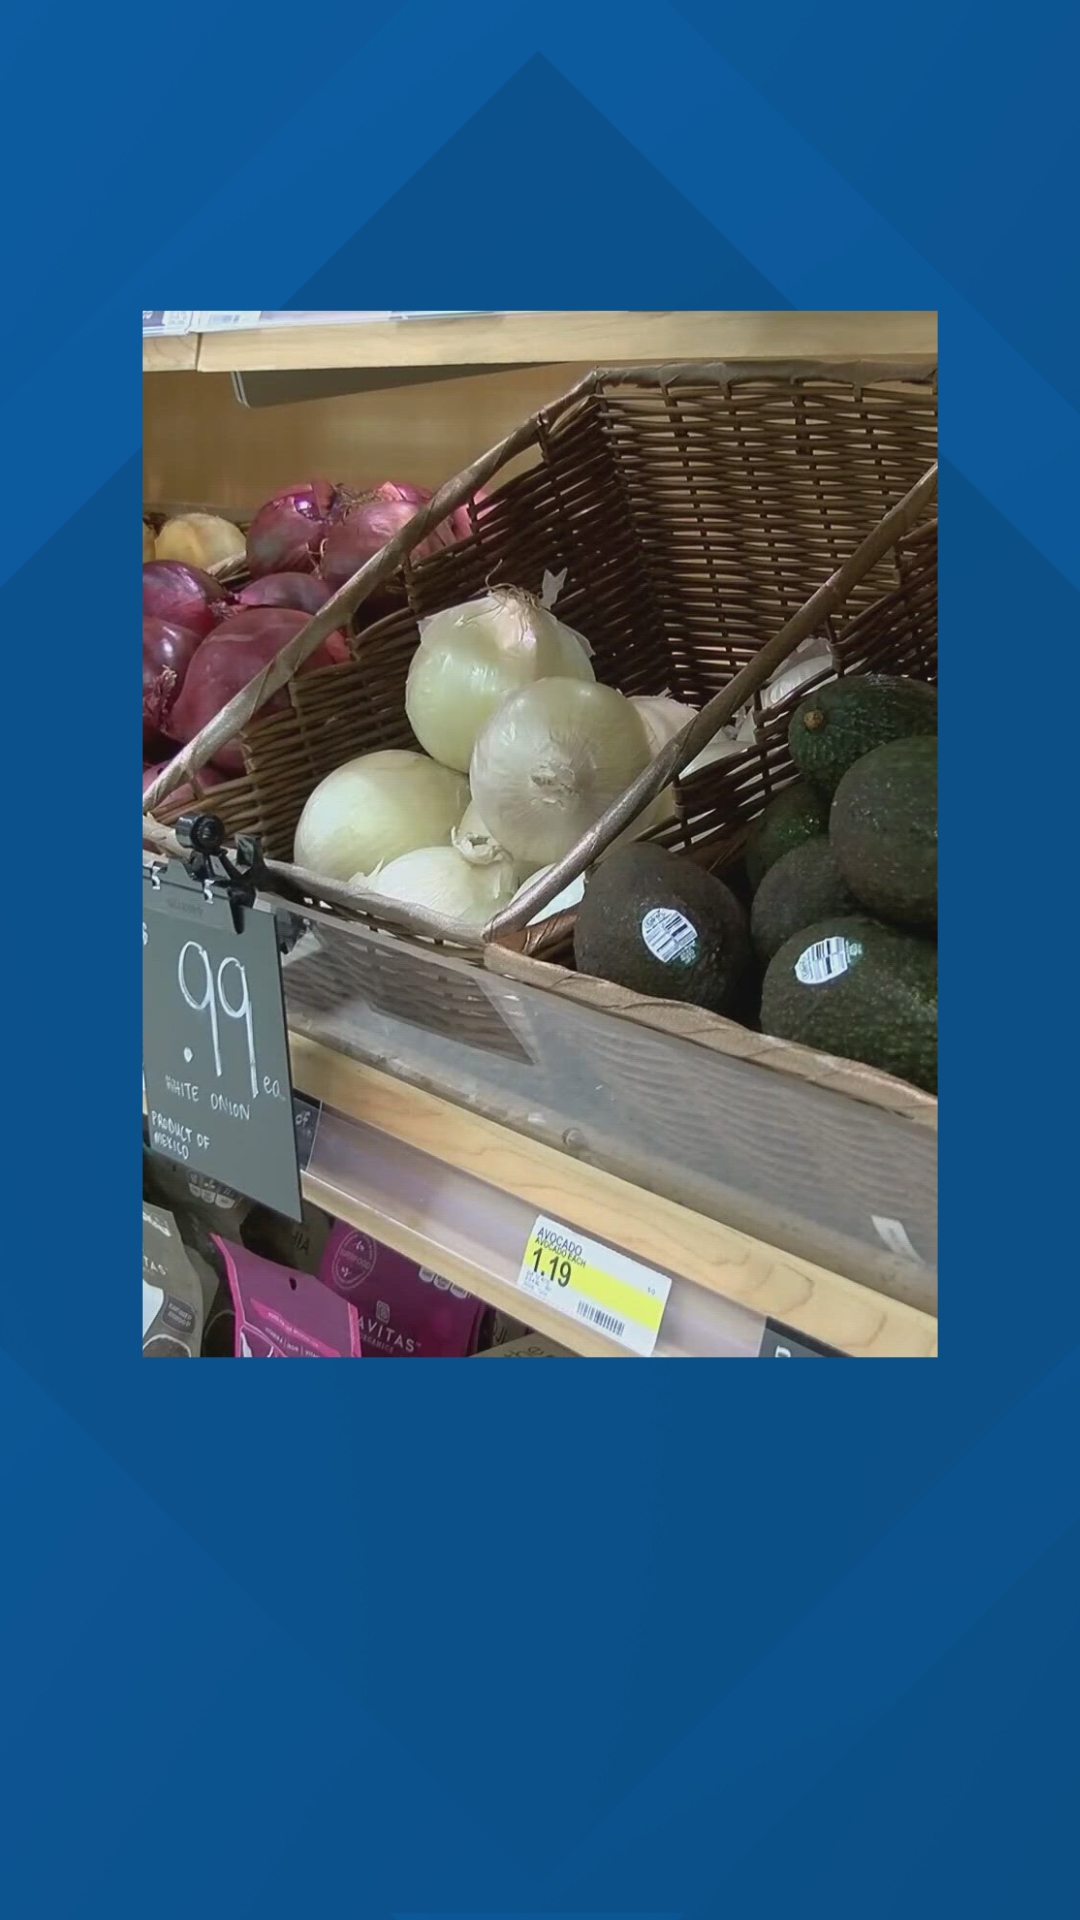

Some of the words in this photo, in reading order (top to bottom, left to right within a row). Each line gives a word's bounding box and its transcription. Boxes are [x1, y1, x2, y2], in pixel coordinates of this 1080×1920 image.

[178, 940, 260, 1099] .99
[165, 1074, 200, 1102] WHITE
[210, 1092, 251, 1121] ONION
[151, 1110, 193, 1144] PRODUCT
[196, 1133, 211, 1150] OF
[154, 1131, 190, 1160] MEXICO
[534, 1236, 567, 1259] AVOCADO
[567, 1252, 587, 1269] EACH
[537, 1226, 583, 1257] AVOCADO
[532, 1247, 572, 1288] 1.19
[358, 1315, 415, 1353] AVITAS
